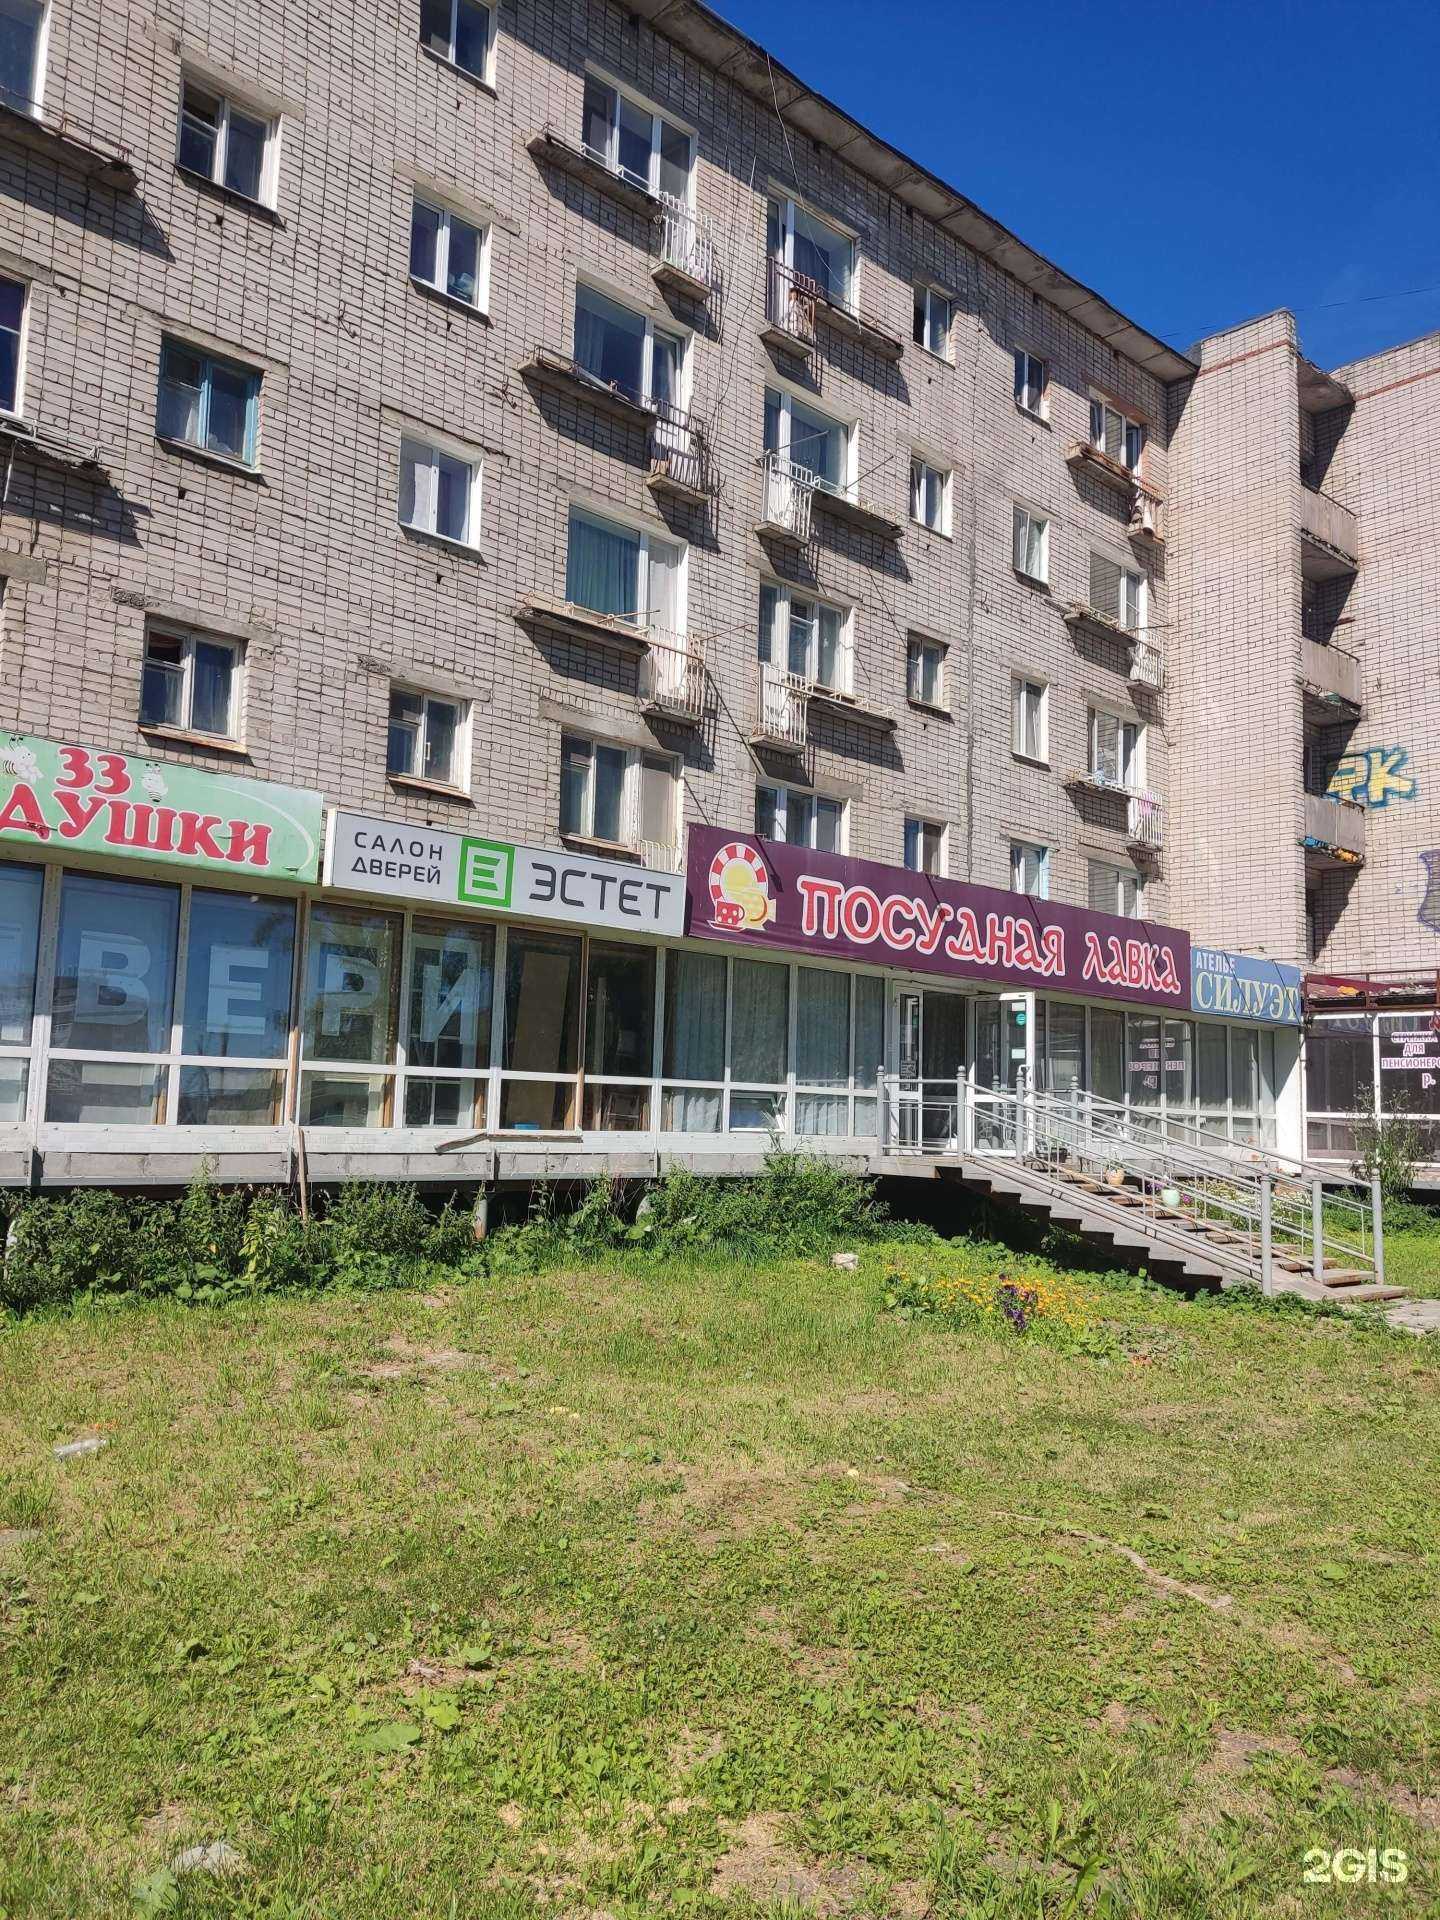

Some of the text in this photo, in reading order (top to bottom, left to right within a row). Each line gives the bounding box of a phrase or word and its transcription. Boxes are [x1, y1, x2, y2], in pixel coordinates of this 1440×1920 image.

[56, 747, 132, 796] 33
[354, 831, 443, 861] САЛОН
[351, 856, 441, 885] ДВЕРЕЙ
[529, 862, 671, 919] ЭСТЕТ
[1195, 951, 1236, 975] АТЕЛЬЕ
[1196, 971, 1299, 1020] СИЛУЭТ
[1403, 1043, 1425, 1057] ДЛЯ
